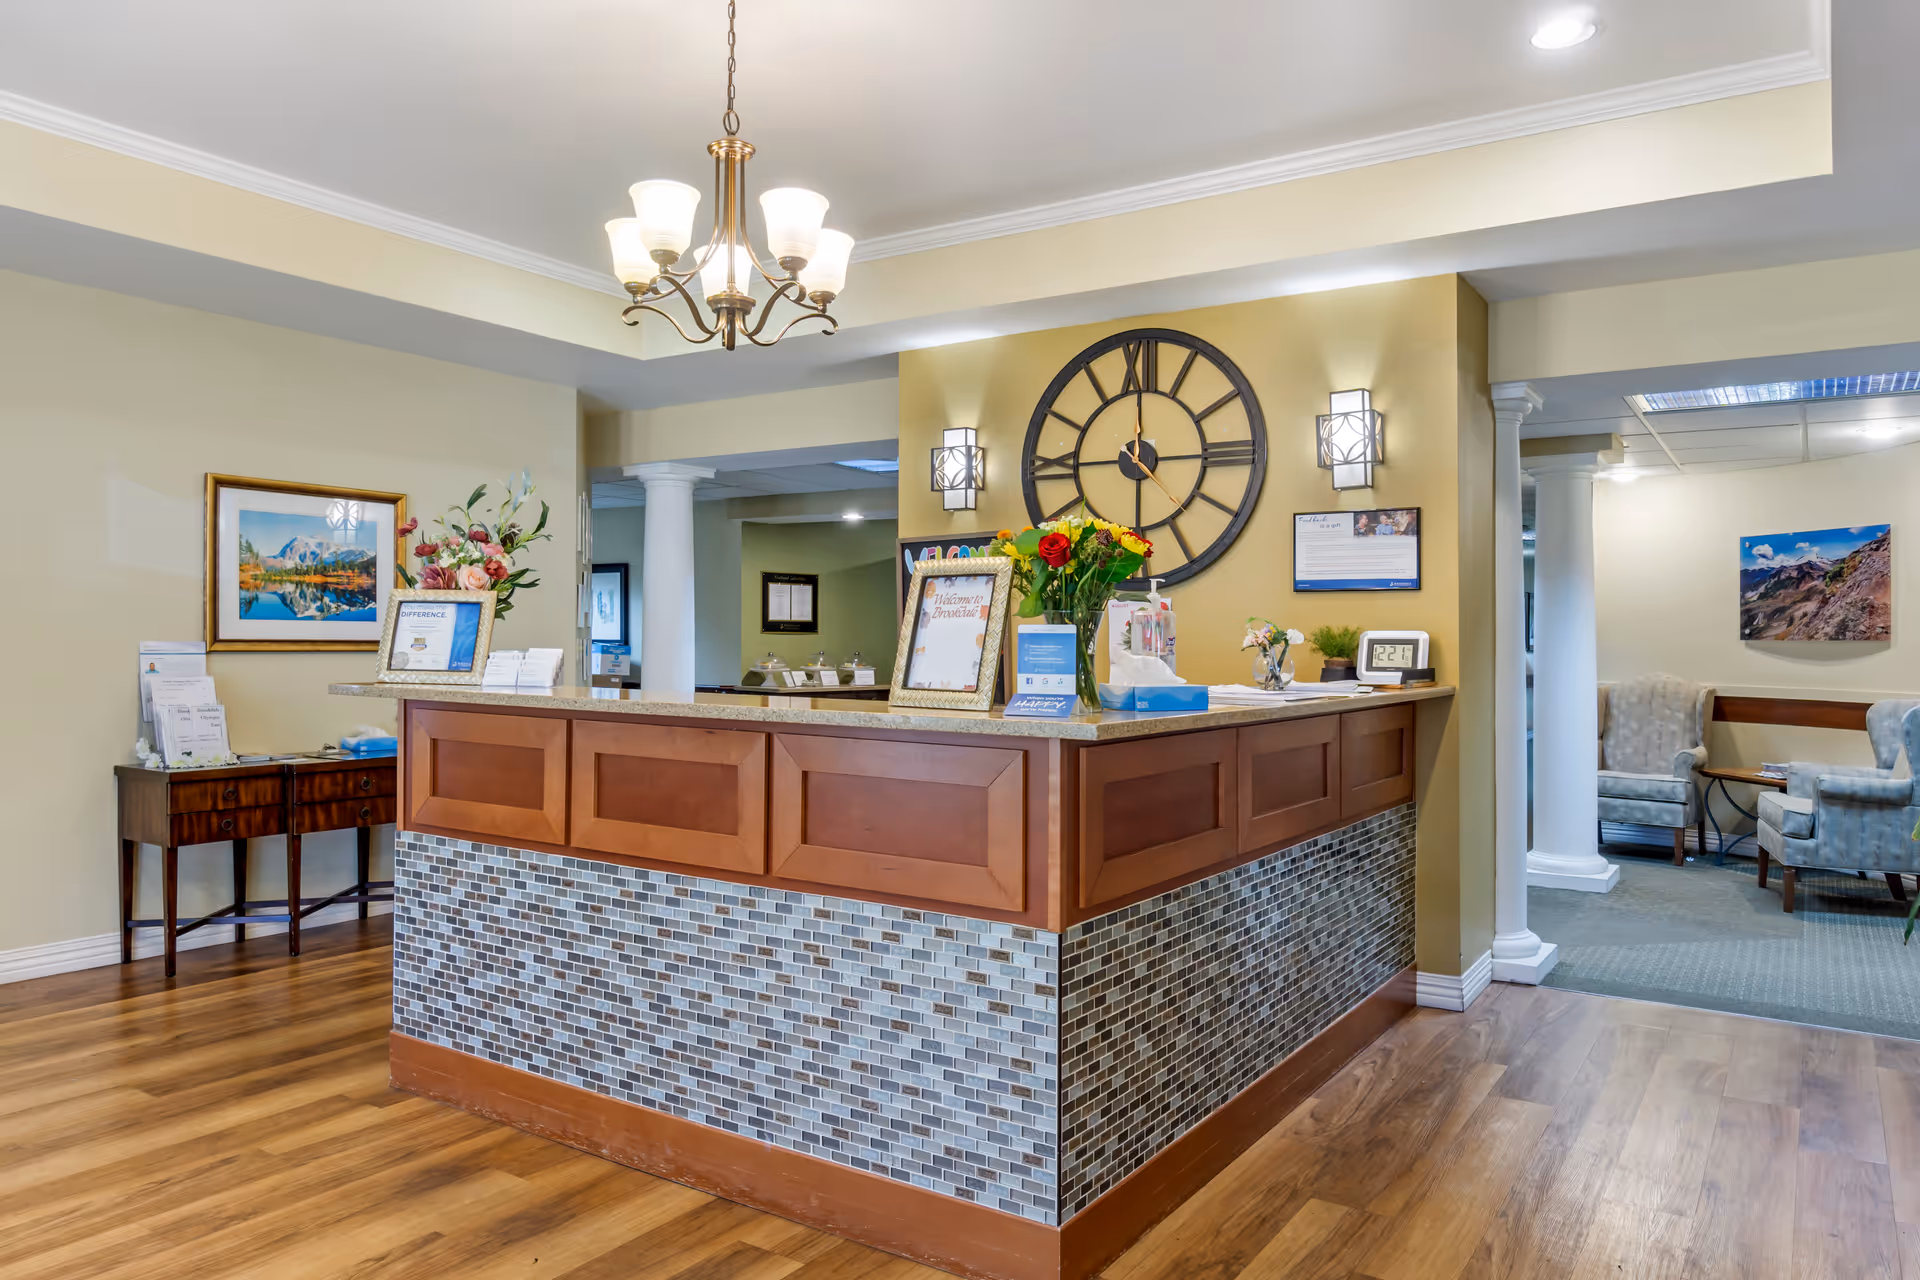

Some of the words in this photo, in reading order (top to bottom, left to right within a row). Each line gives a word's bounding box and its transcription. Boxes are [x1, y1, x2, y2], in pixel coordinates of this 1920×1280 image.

[934, 592, 973, 606] Welcome
[973, 595, 984, 605] to
[931, 606, 979, 619] Brookdale
